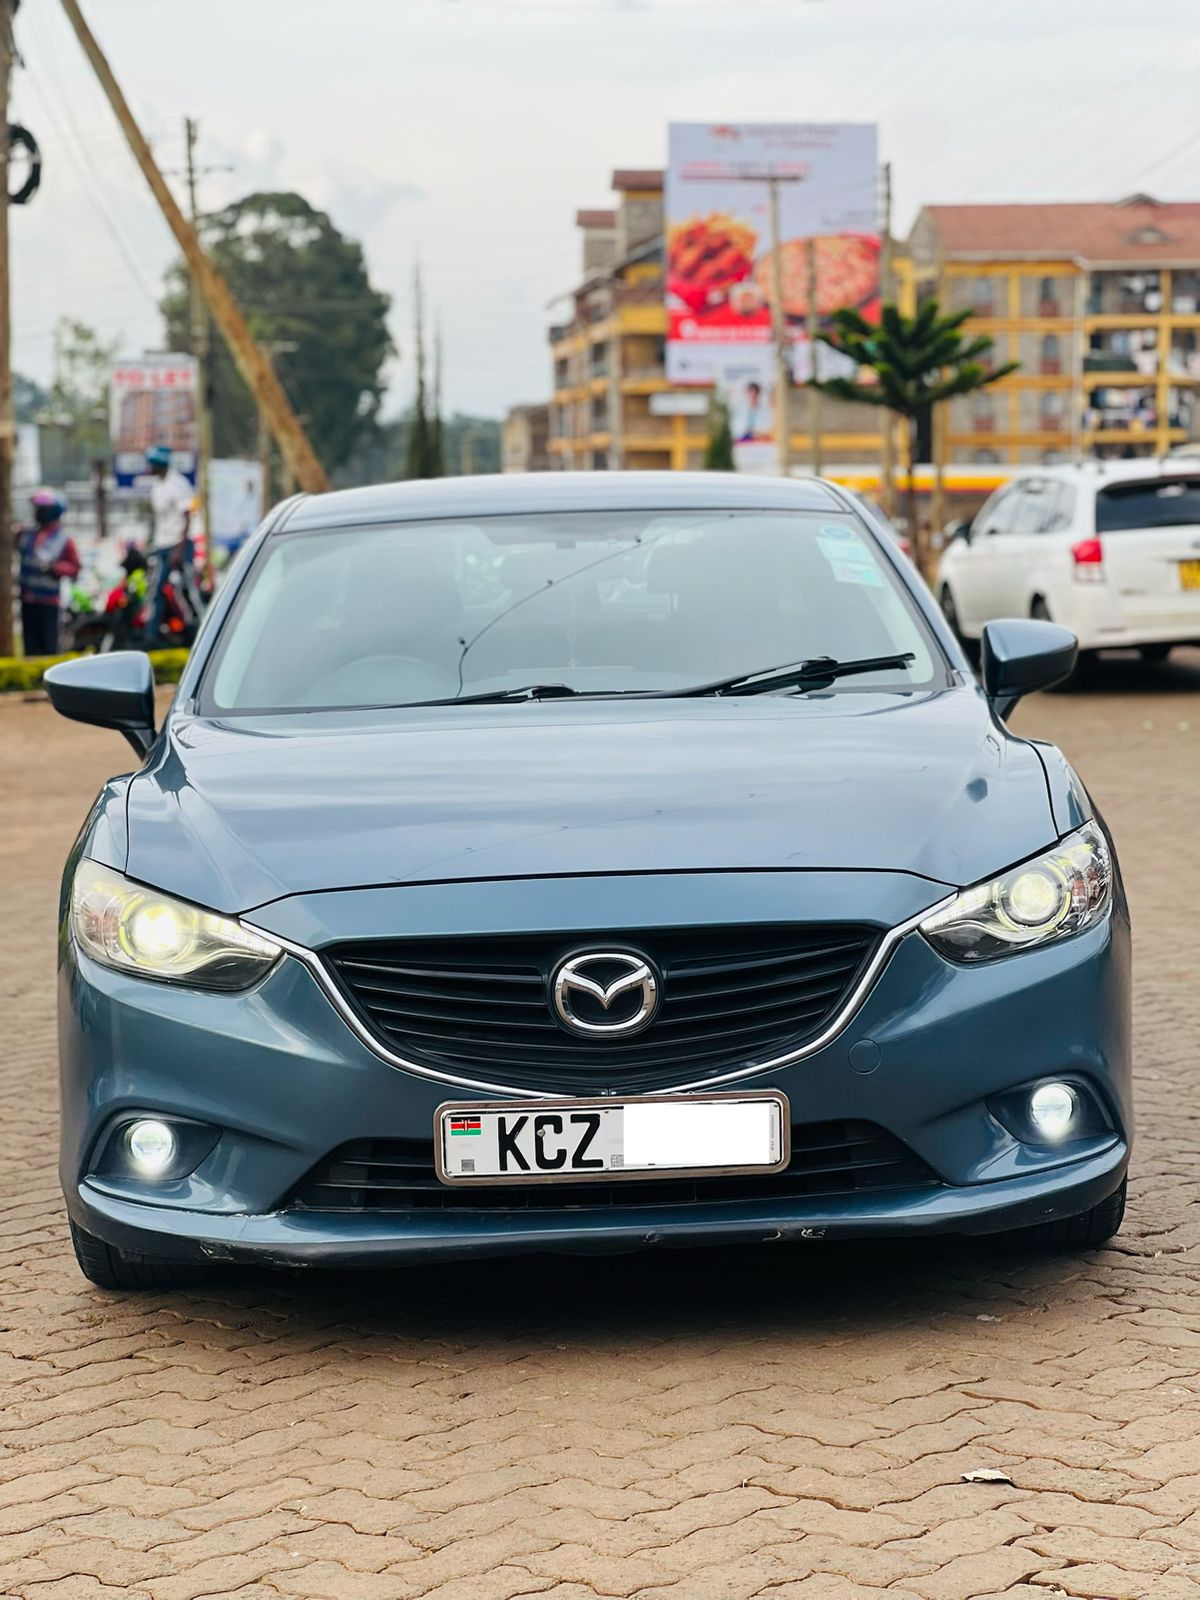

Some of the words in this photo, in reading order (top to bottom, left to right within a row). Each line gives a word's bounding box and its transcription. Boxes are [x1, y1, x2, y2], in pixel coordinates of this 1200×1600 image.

[113, 368, 144, 387] TO
[151, 368, 192, 388] LET
[498, 1114, 604, 1171] KCZ
